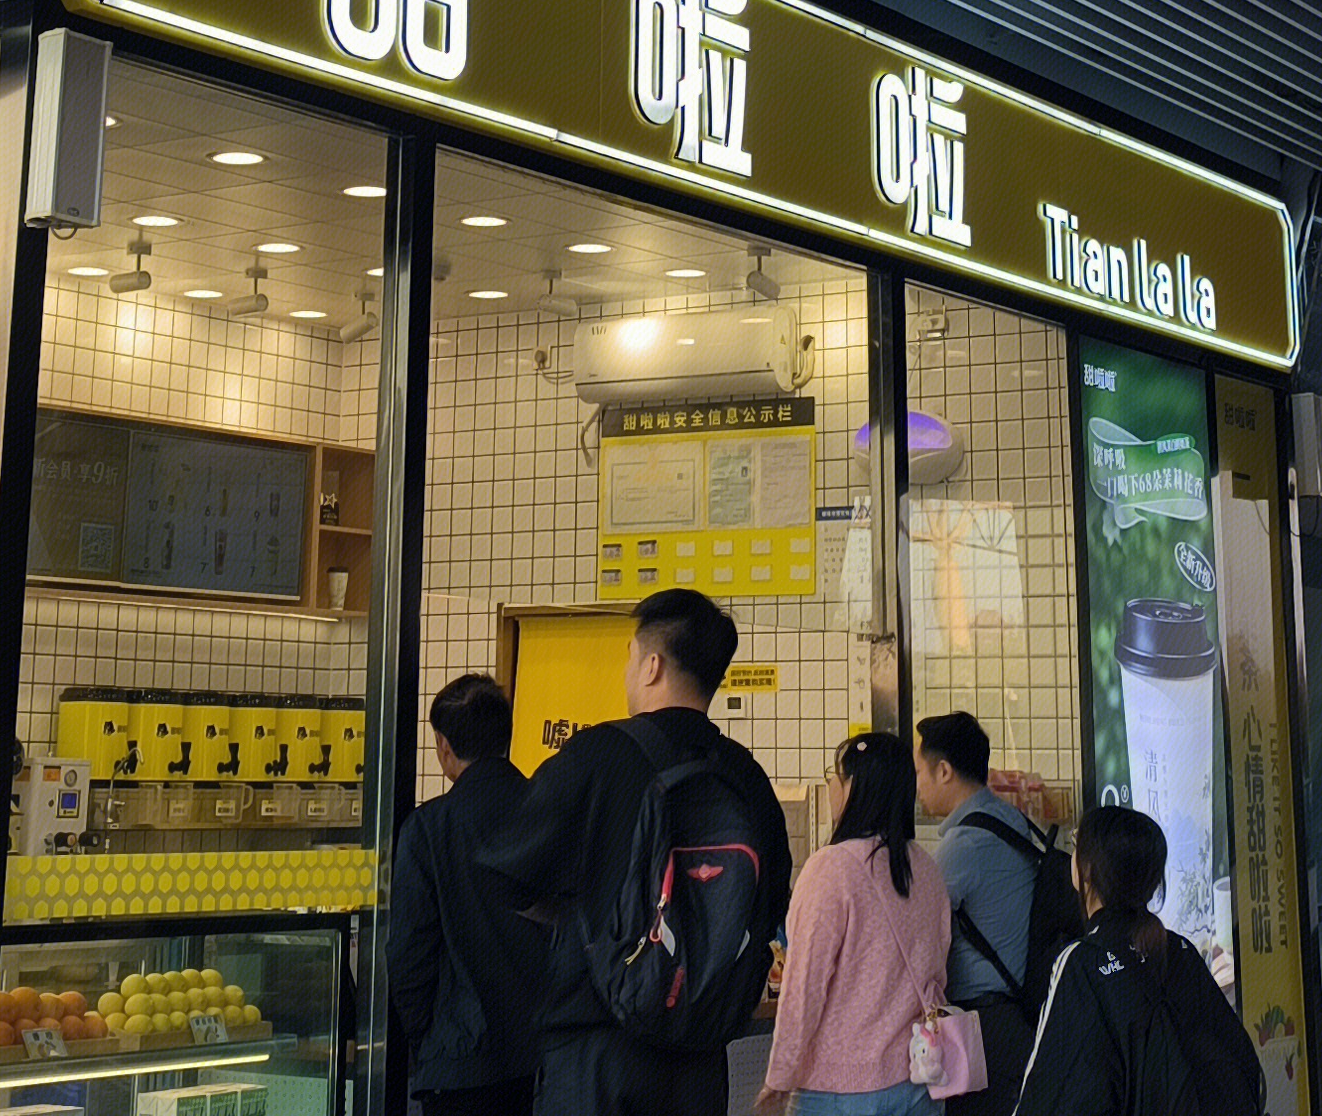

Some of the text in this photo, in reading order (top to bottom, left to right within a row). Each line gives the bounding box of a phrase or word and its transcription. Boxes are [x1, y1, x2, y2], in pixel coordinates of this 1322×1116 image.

[623, 404, 793, 431] 甜啦啦安全信息公示栏
[1093, 441, 1126, 471] 深呼吸
[1274, 824, 1284, 860] SO
[1276, 868, 1289, 950] SWEET
